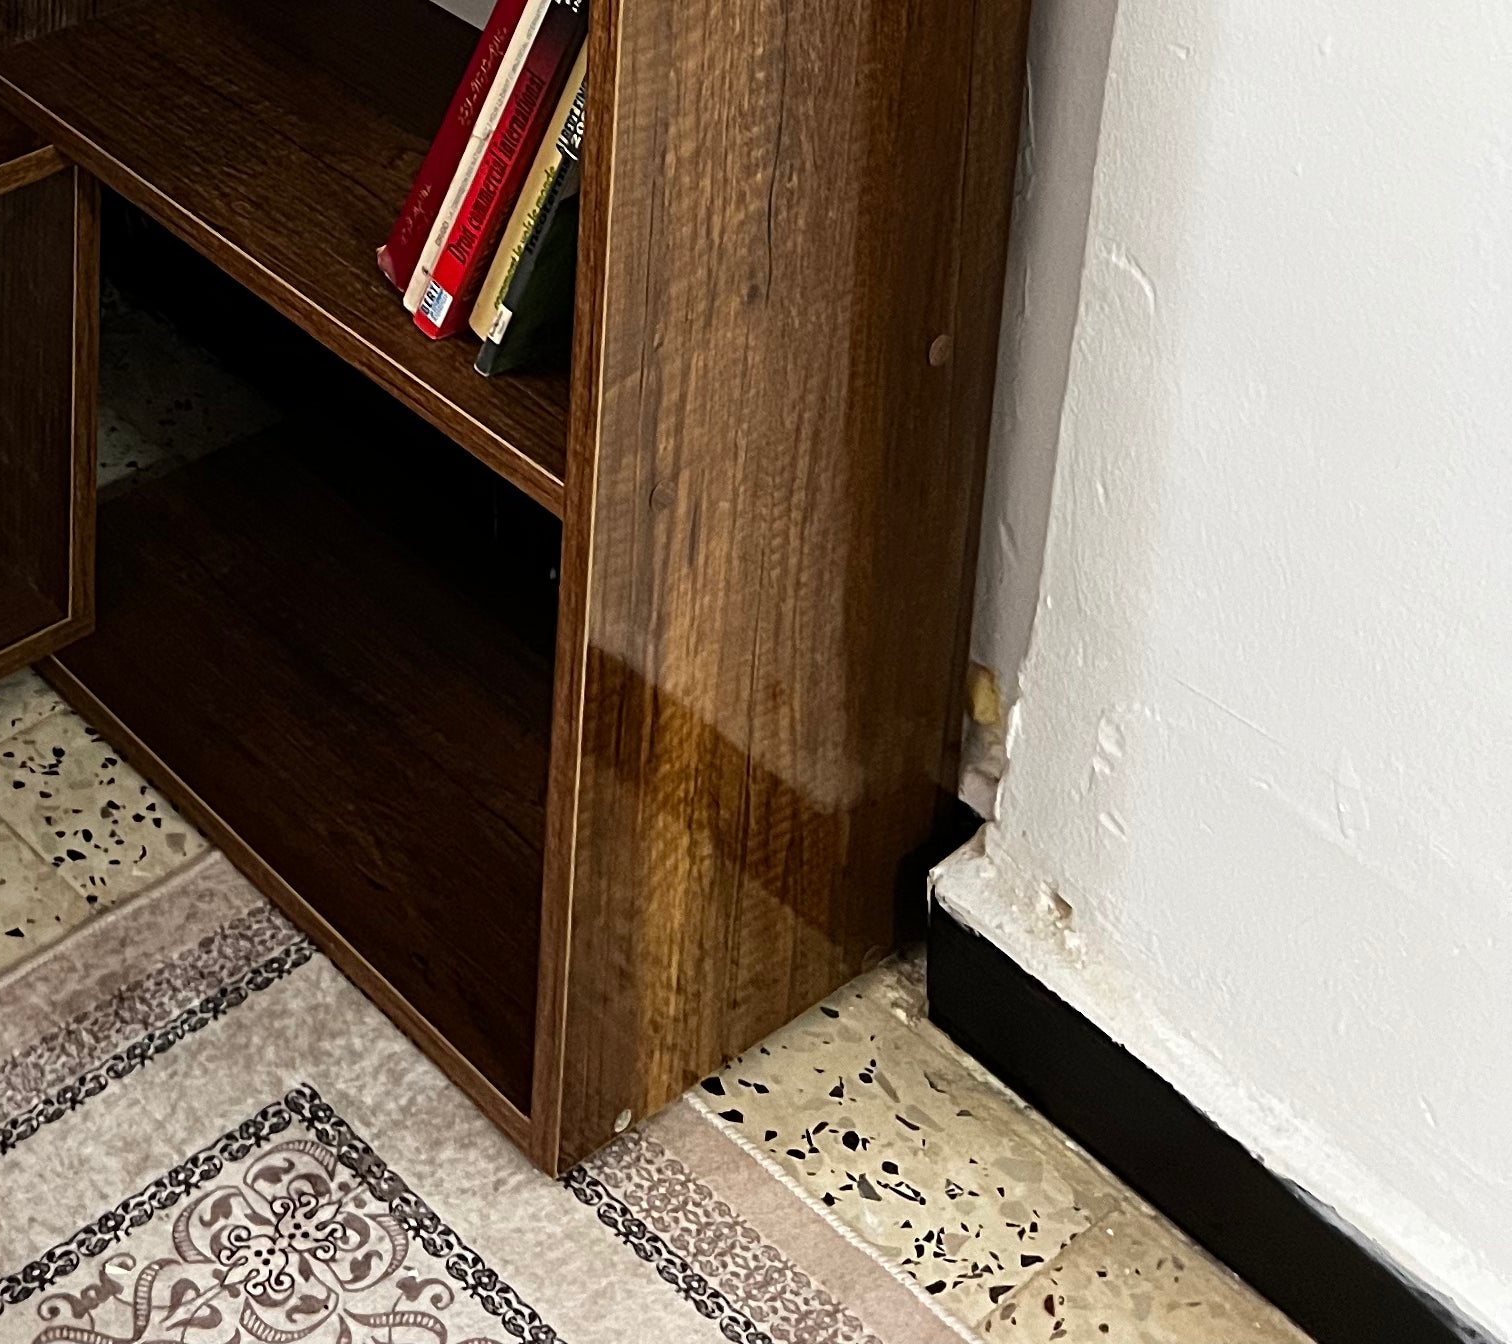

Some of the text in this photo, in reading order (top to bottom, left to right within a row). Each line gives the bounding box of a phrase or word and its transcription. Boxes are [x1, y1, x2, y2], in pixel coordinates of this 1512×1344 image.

[447, 224, 476, 265] Droit
[467, 148, 508, 232] commercial
[497, 69, 546, 161] international
[535, 165, 555, 210] monde
